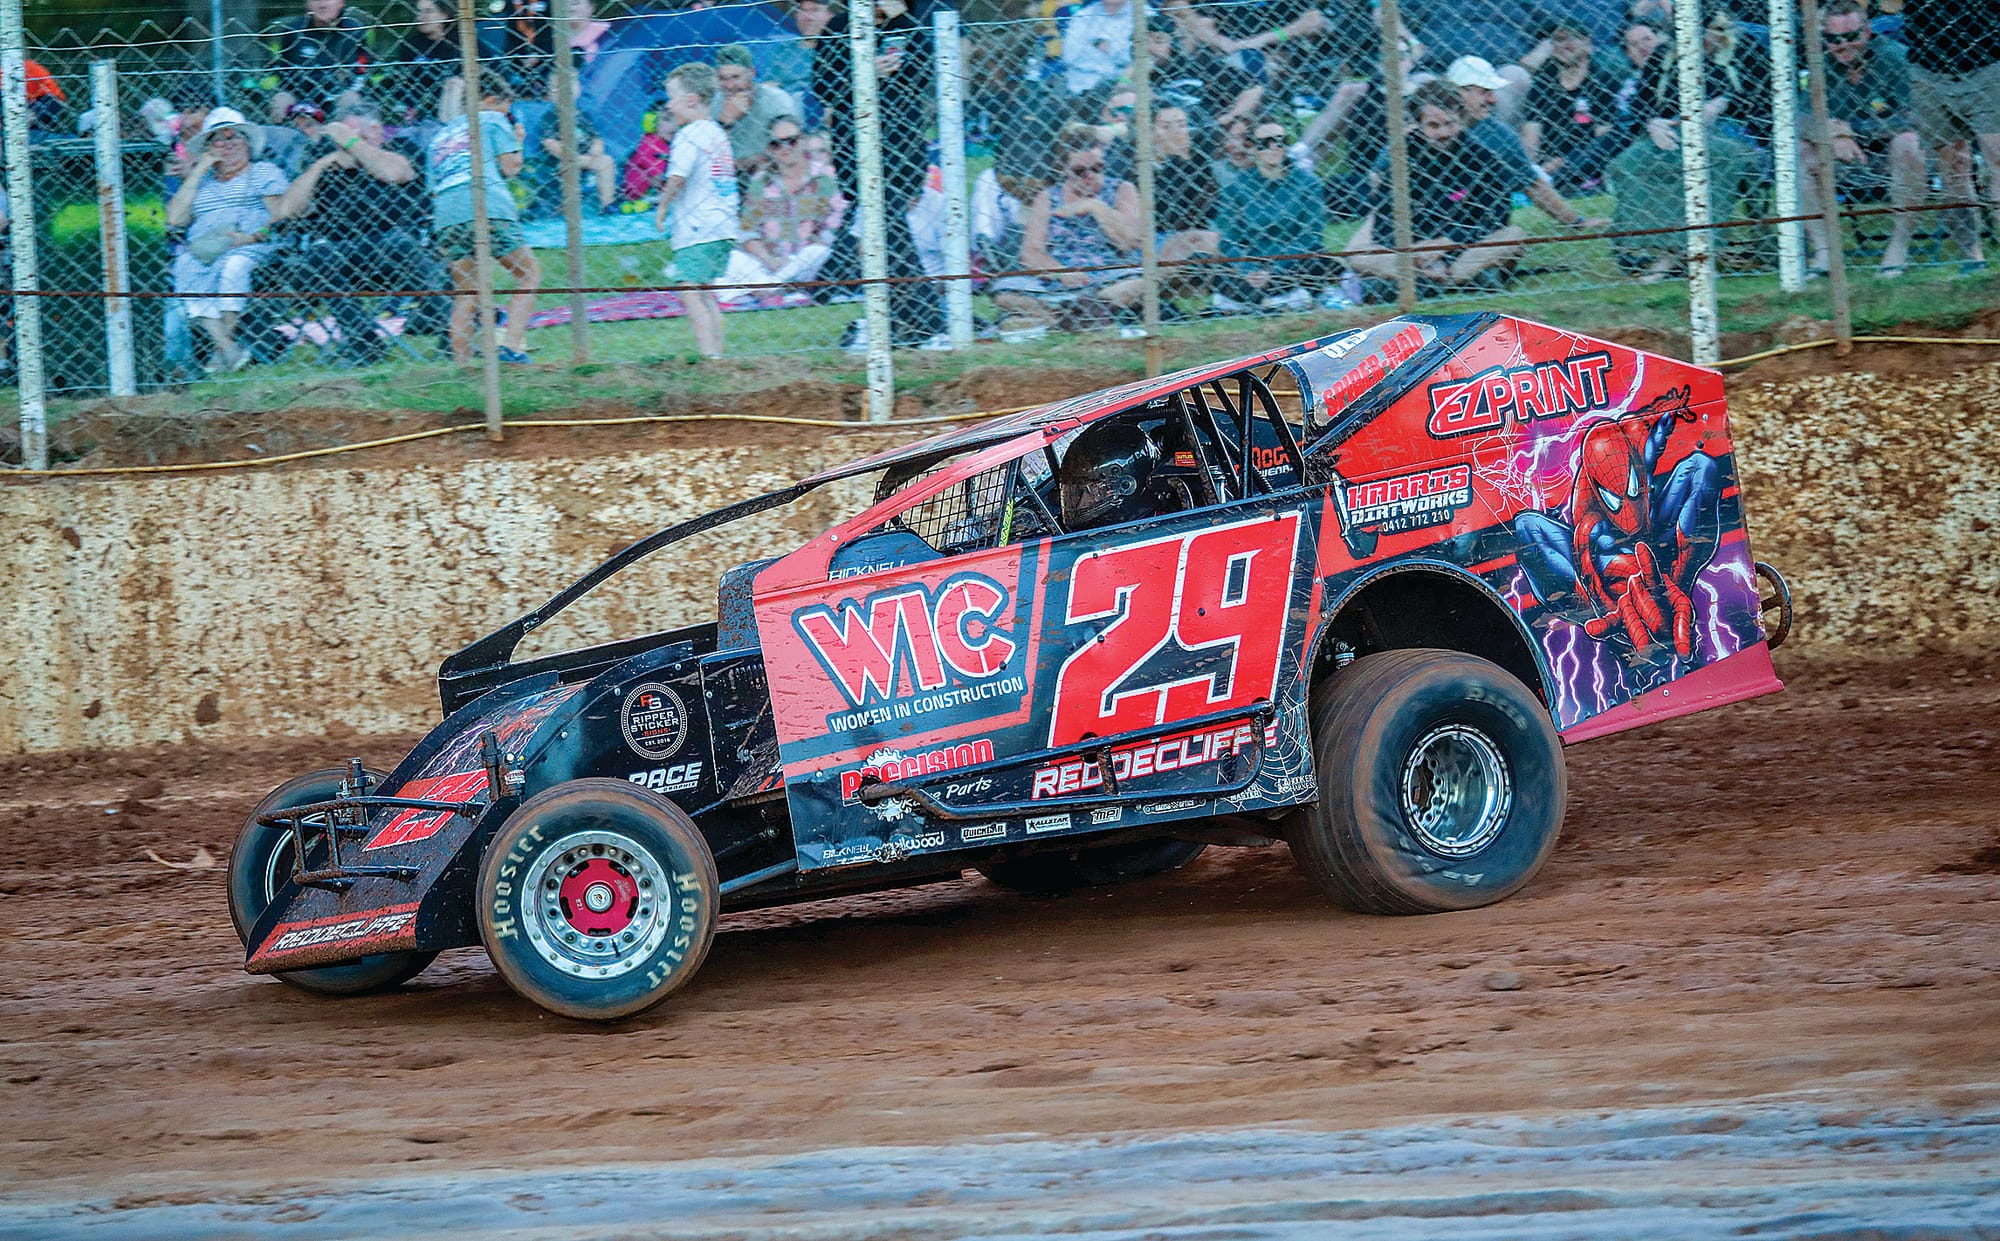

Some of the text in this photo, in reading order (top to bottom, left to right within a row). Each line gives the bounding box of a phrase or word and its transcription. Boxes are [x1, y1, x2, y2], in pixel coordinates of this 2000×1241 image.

[1428, 355, 1609, 434] EZPRINT
[1347, 465, 1470, 511] HARRIS
[1351, 488, 1469, 525] DIRTWORKS
[1383, 509, 1450, 532] 0412 772 210
[798, 579, 1016, 706] WIC
[1044, 510, 1304, 766] 29
[630, 717, 680, 733] STICKER
[632, 710, 675, 726] RIPPER
[830, 676, 1024, 733] WOMEN IN CONSTRUCTION
[946, 777, 992, 799] Parts
